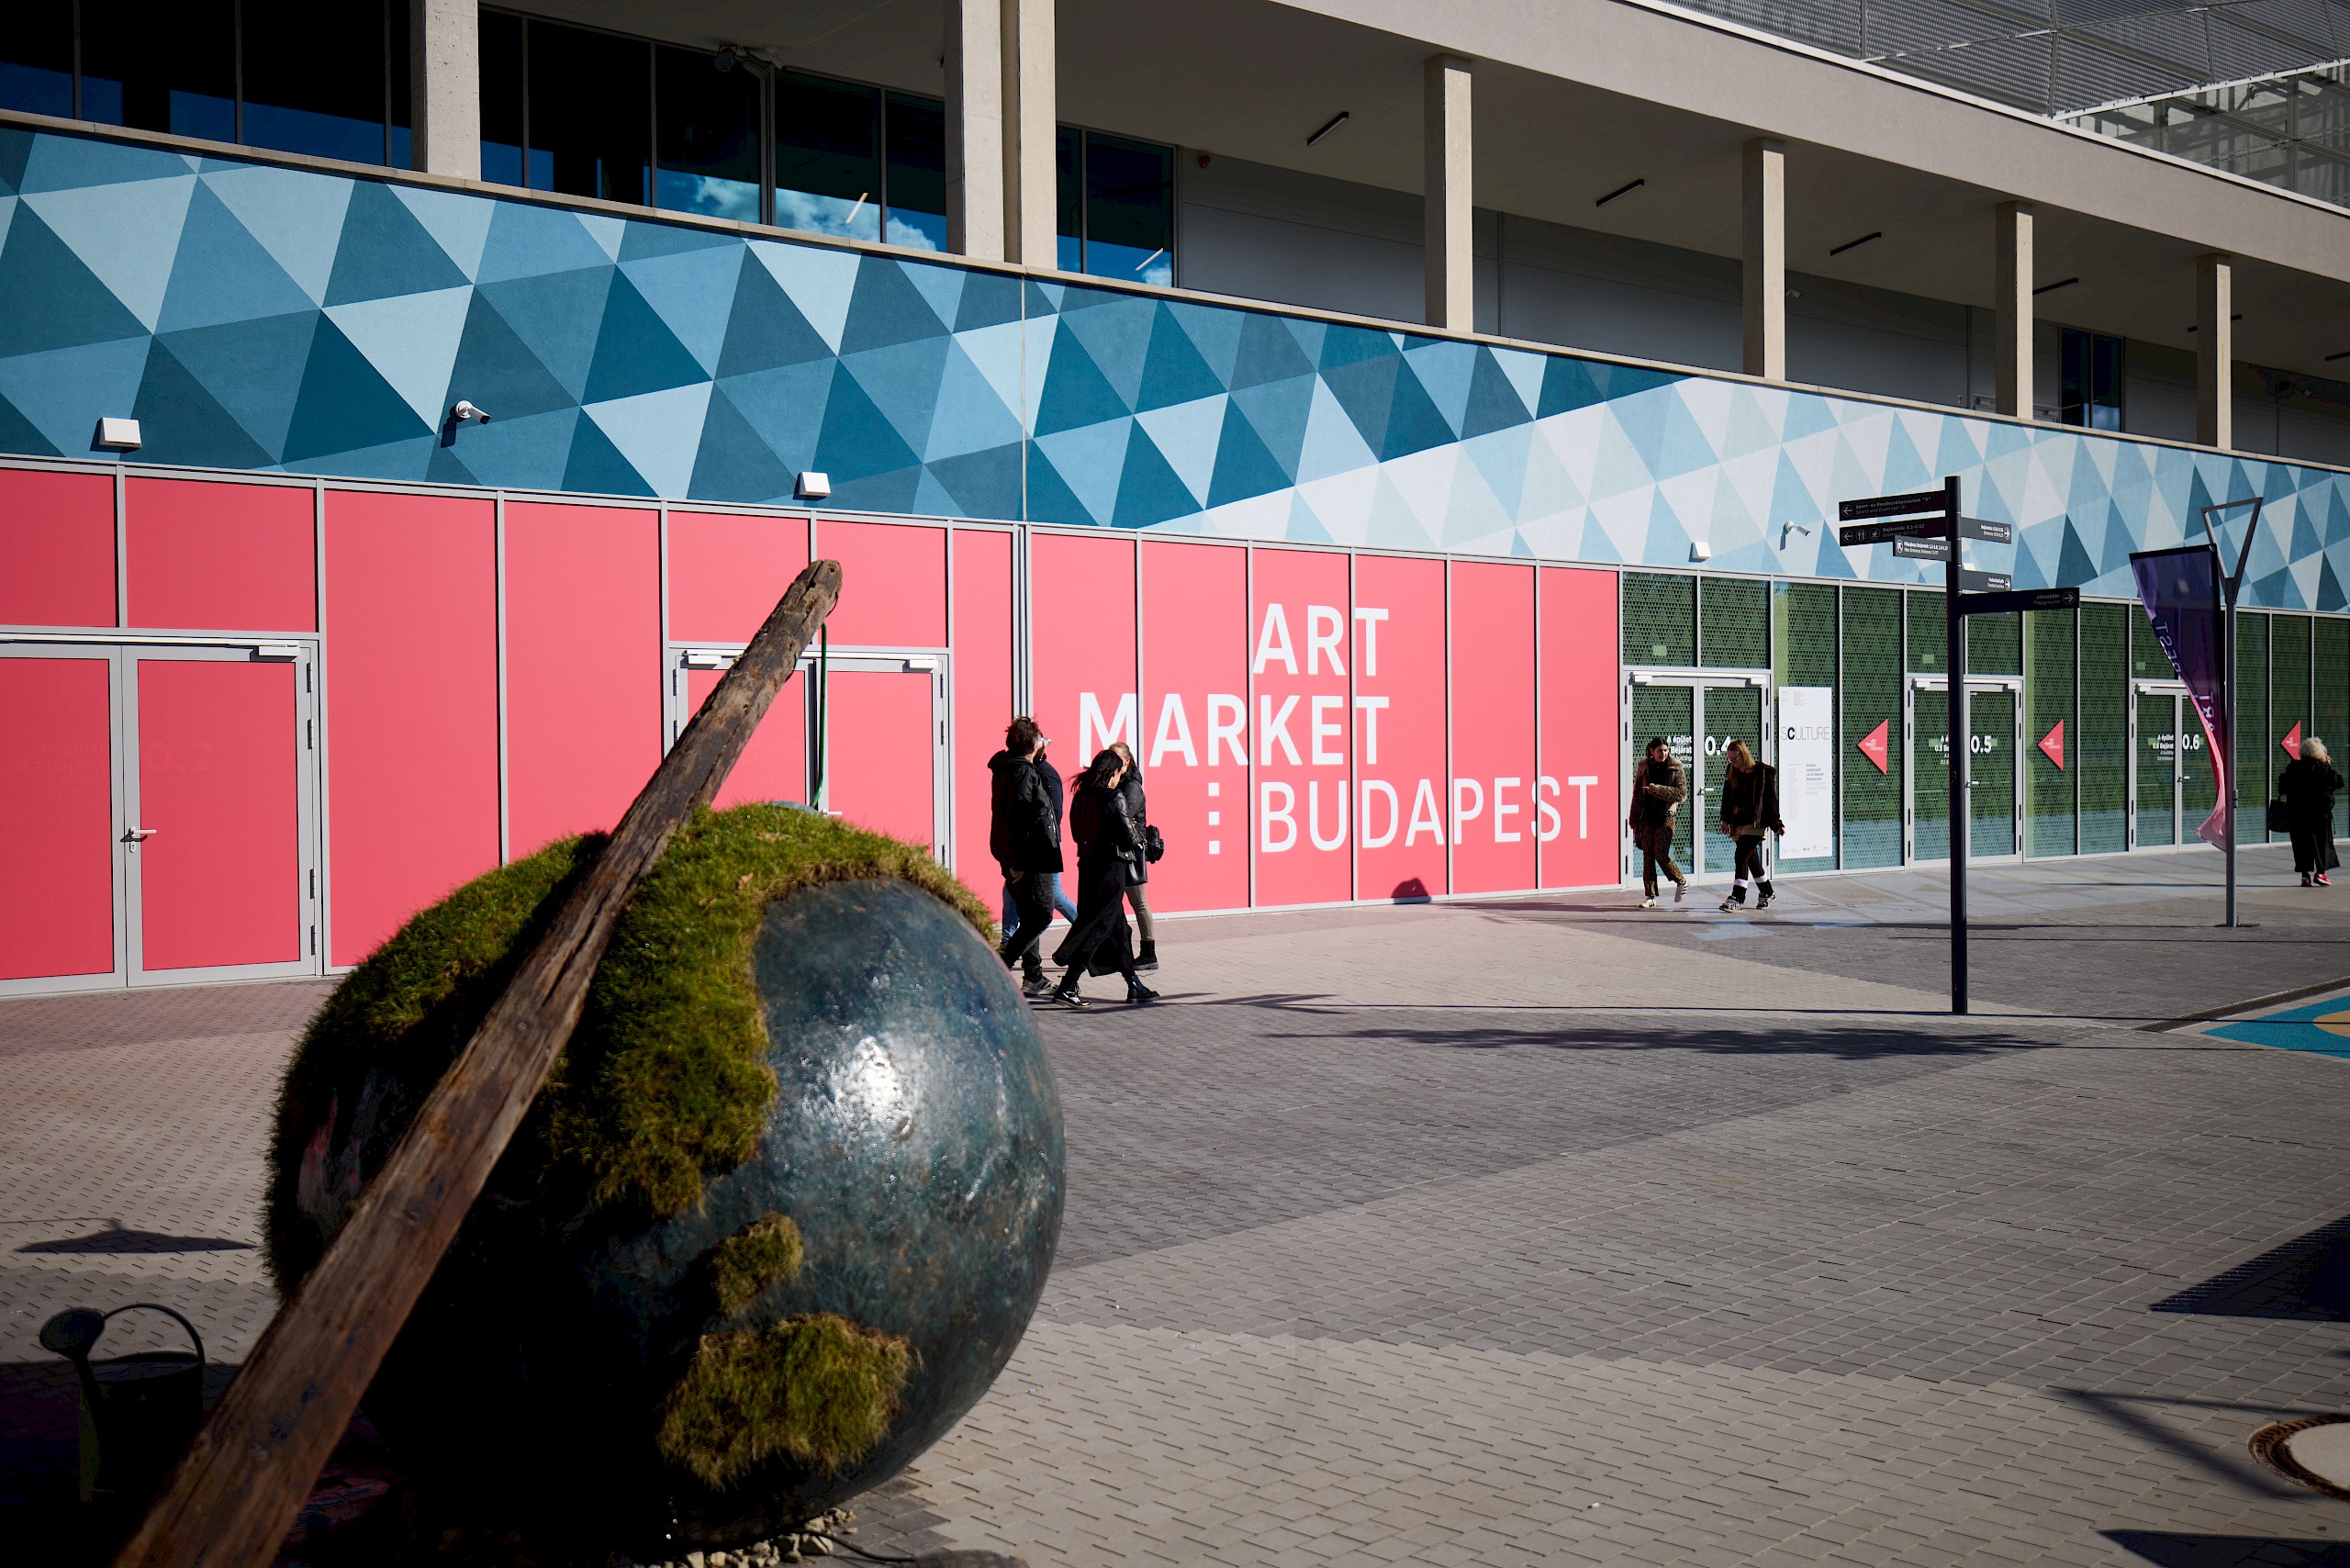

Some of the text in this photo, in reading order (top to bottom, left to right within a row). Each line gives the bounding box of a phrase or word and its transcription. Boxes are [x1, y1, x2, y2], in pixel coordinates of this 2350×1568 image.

[1253, 602, 1389, 676] ART
[1079, 692, 1390, 767] MARKET
[1781, 726, 1830, 740] SCULTURE
[1673, 735, 1692, 744] épület
[1705, 736, 1731, 756] 0.4
[1971, 735, 1992, 753] 0.5
[2182, 734, 2199, 750] 0.6
[1671, 745, 1692, 754] Bejárat
[1261, 776, 1598, 853] BUDAPEST
